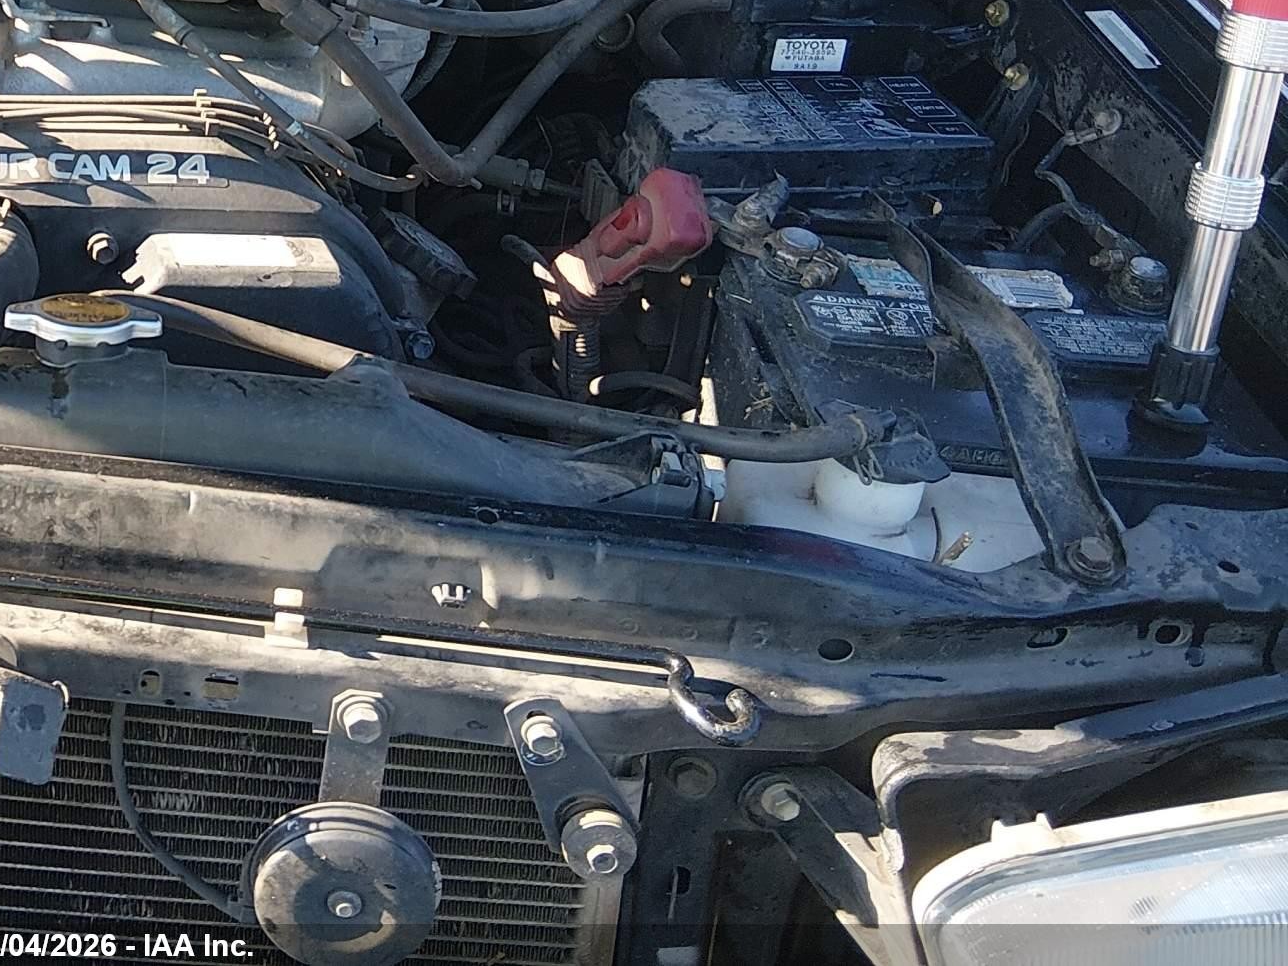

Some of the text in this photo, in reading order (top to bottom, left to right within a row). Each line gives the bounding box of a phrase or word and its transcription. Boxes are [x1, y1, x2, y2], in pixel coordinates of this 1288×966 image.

[785, 40, 836, 51] TOYOTA
[47, 152, 132, 182] CAM
[146, 153, 210, 185] 24
